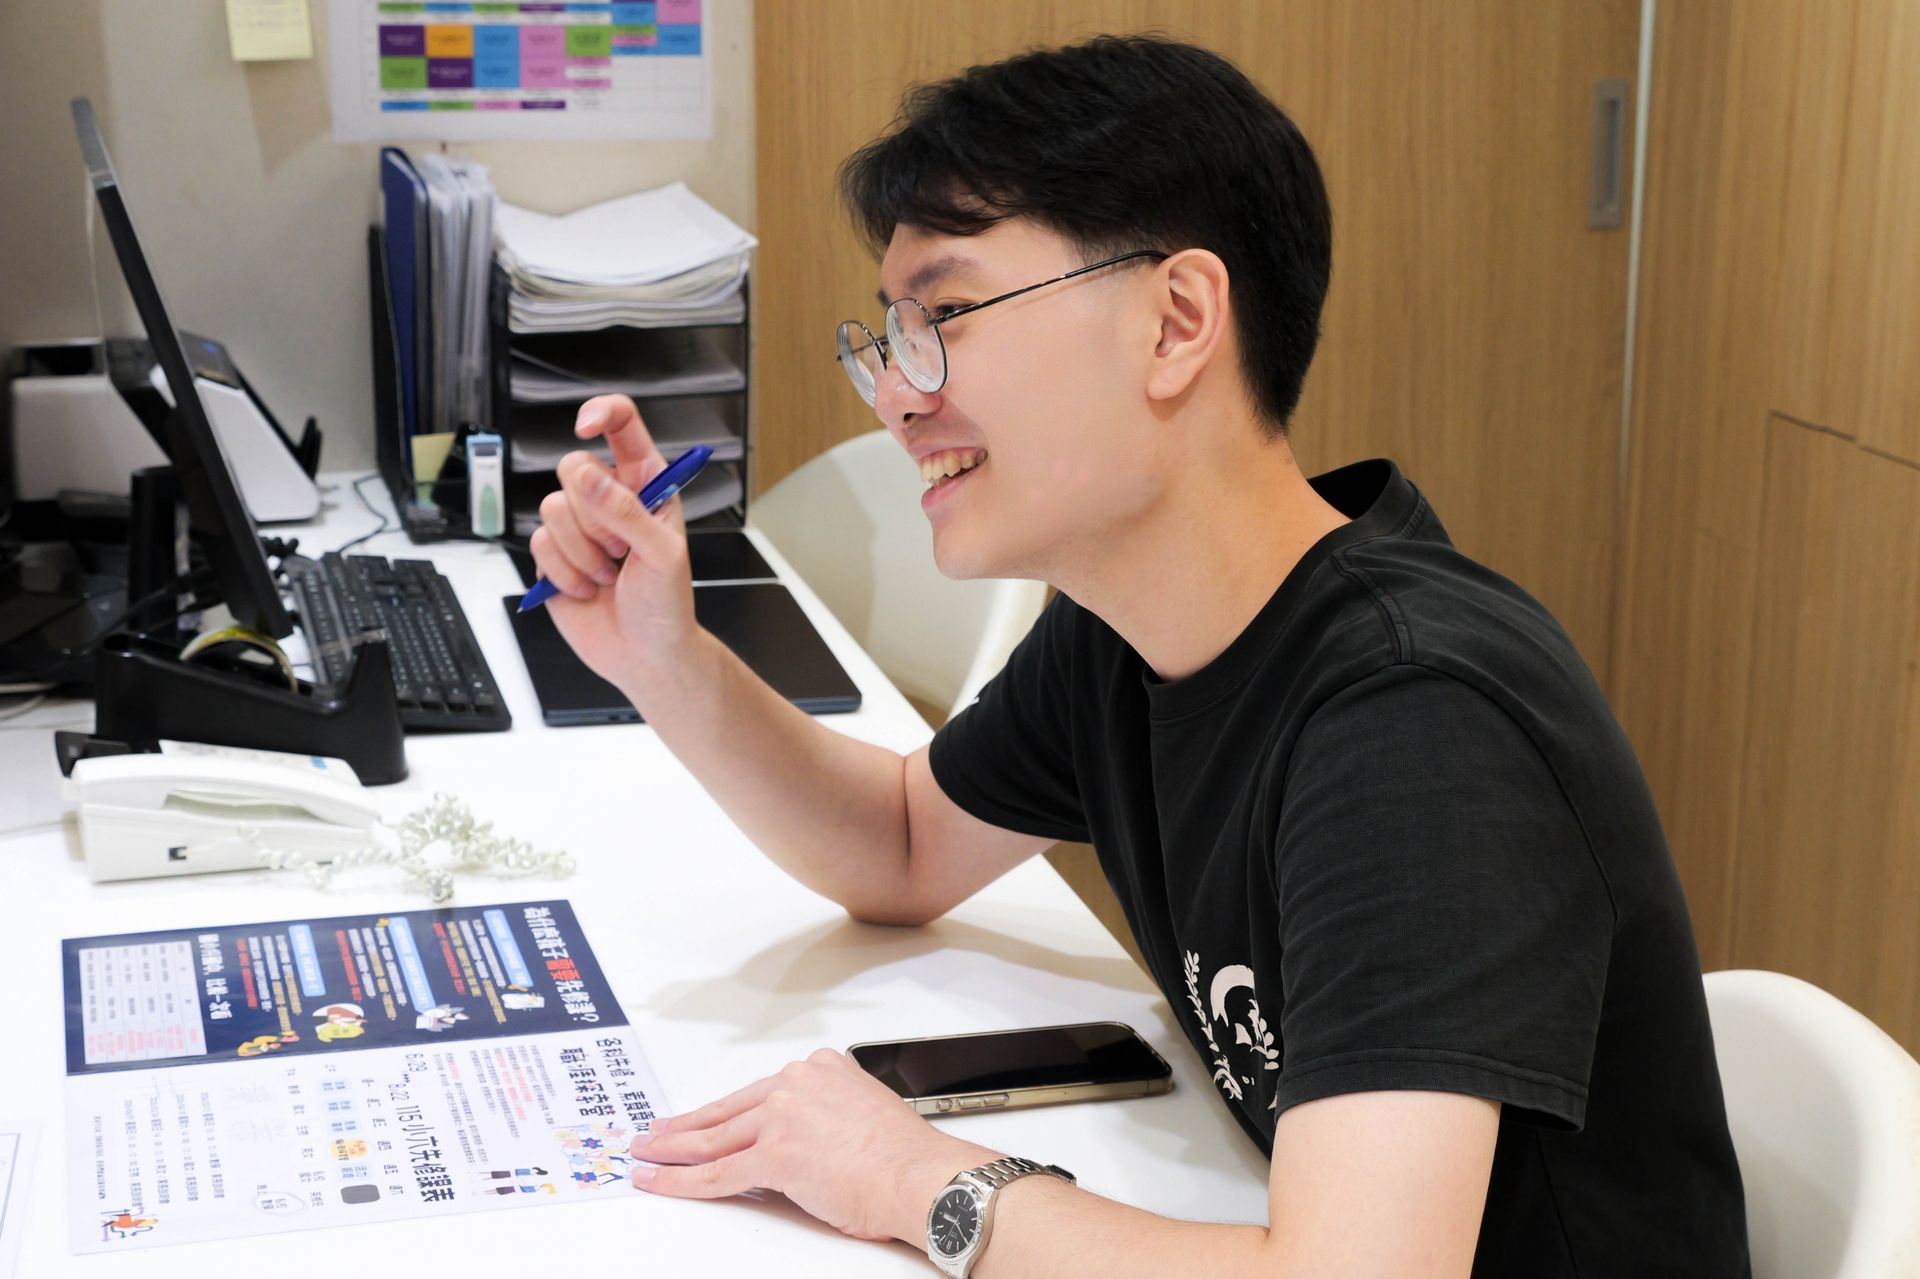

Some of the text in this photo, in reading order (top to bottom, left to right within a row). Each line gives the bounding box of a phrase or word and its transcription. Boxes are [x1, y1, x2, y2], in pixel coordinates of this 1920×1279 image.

[523, 906, 600, 1023] 為什麼孩子需要先修課?
[559, 1047, 616, 1117] 職涯探索營
[595, 1037, 635, 1078] 各科先修
